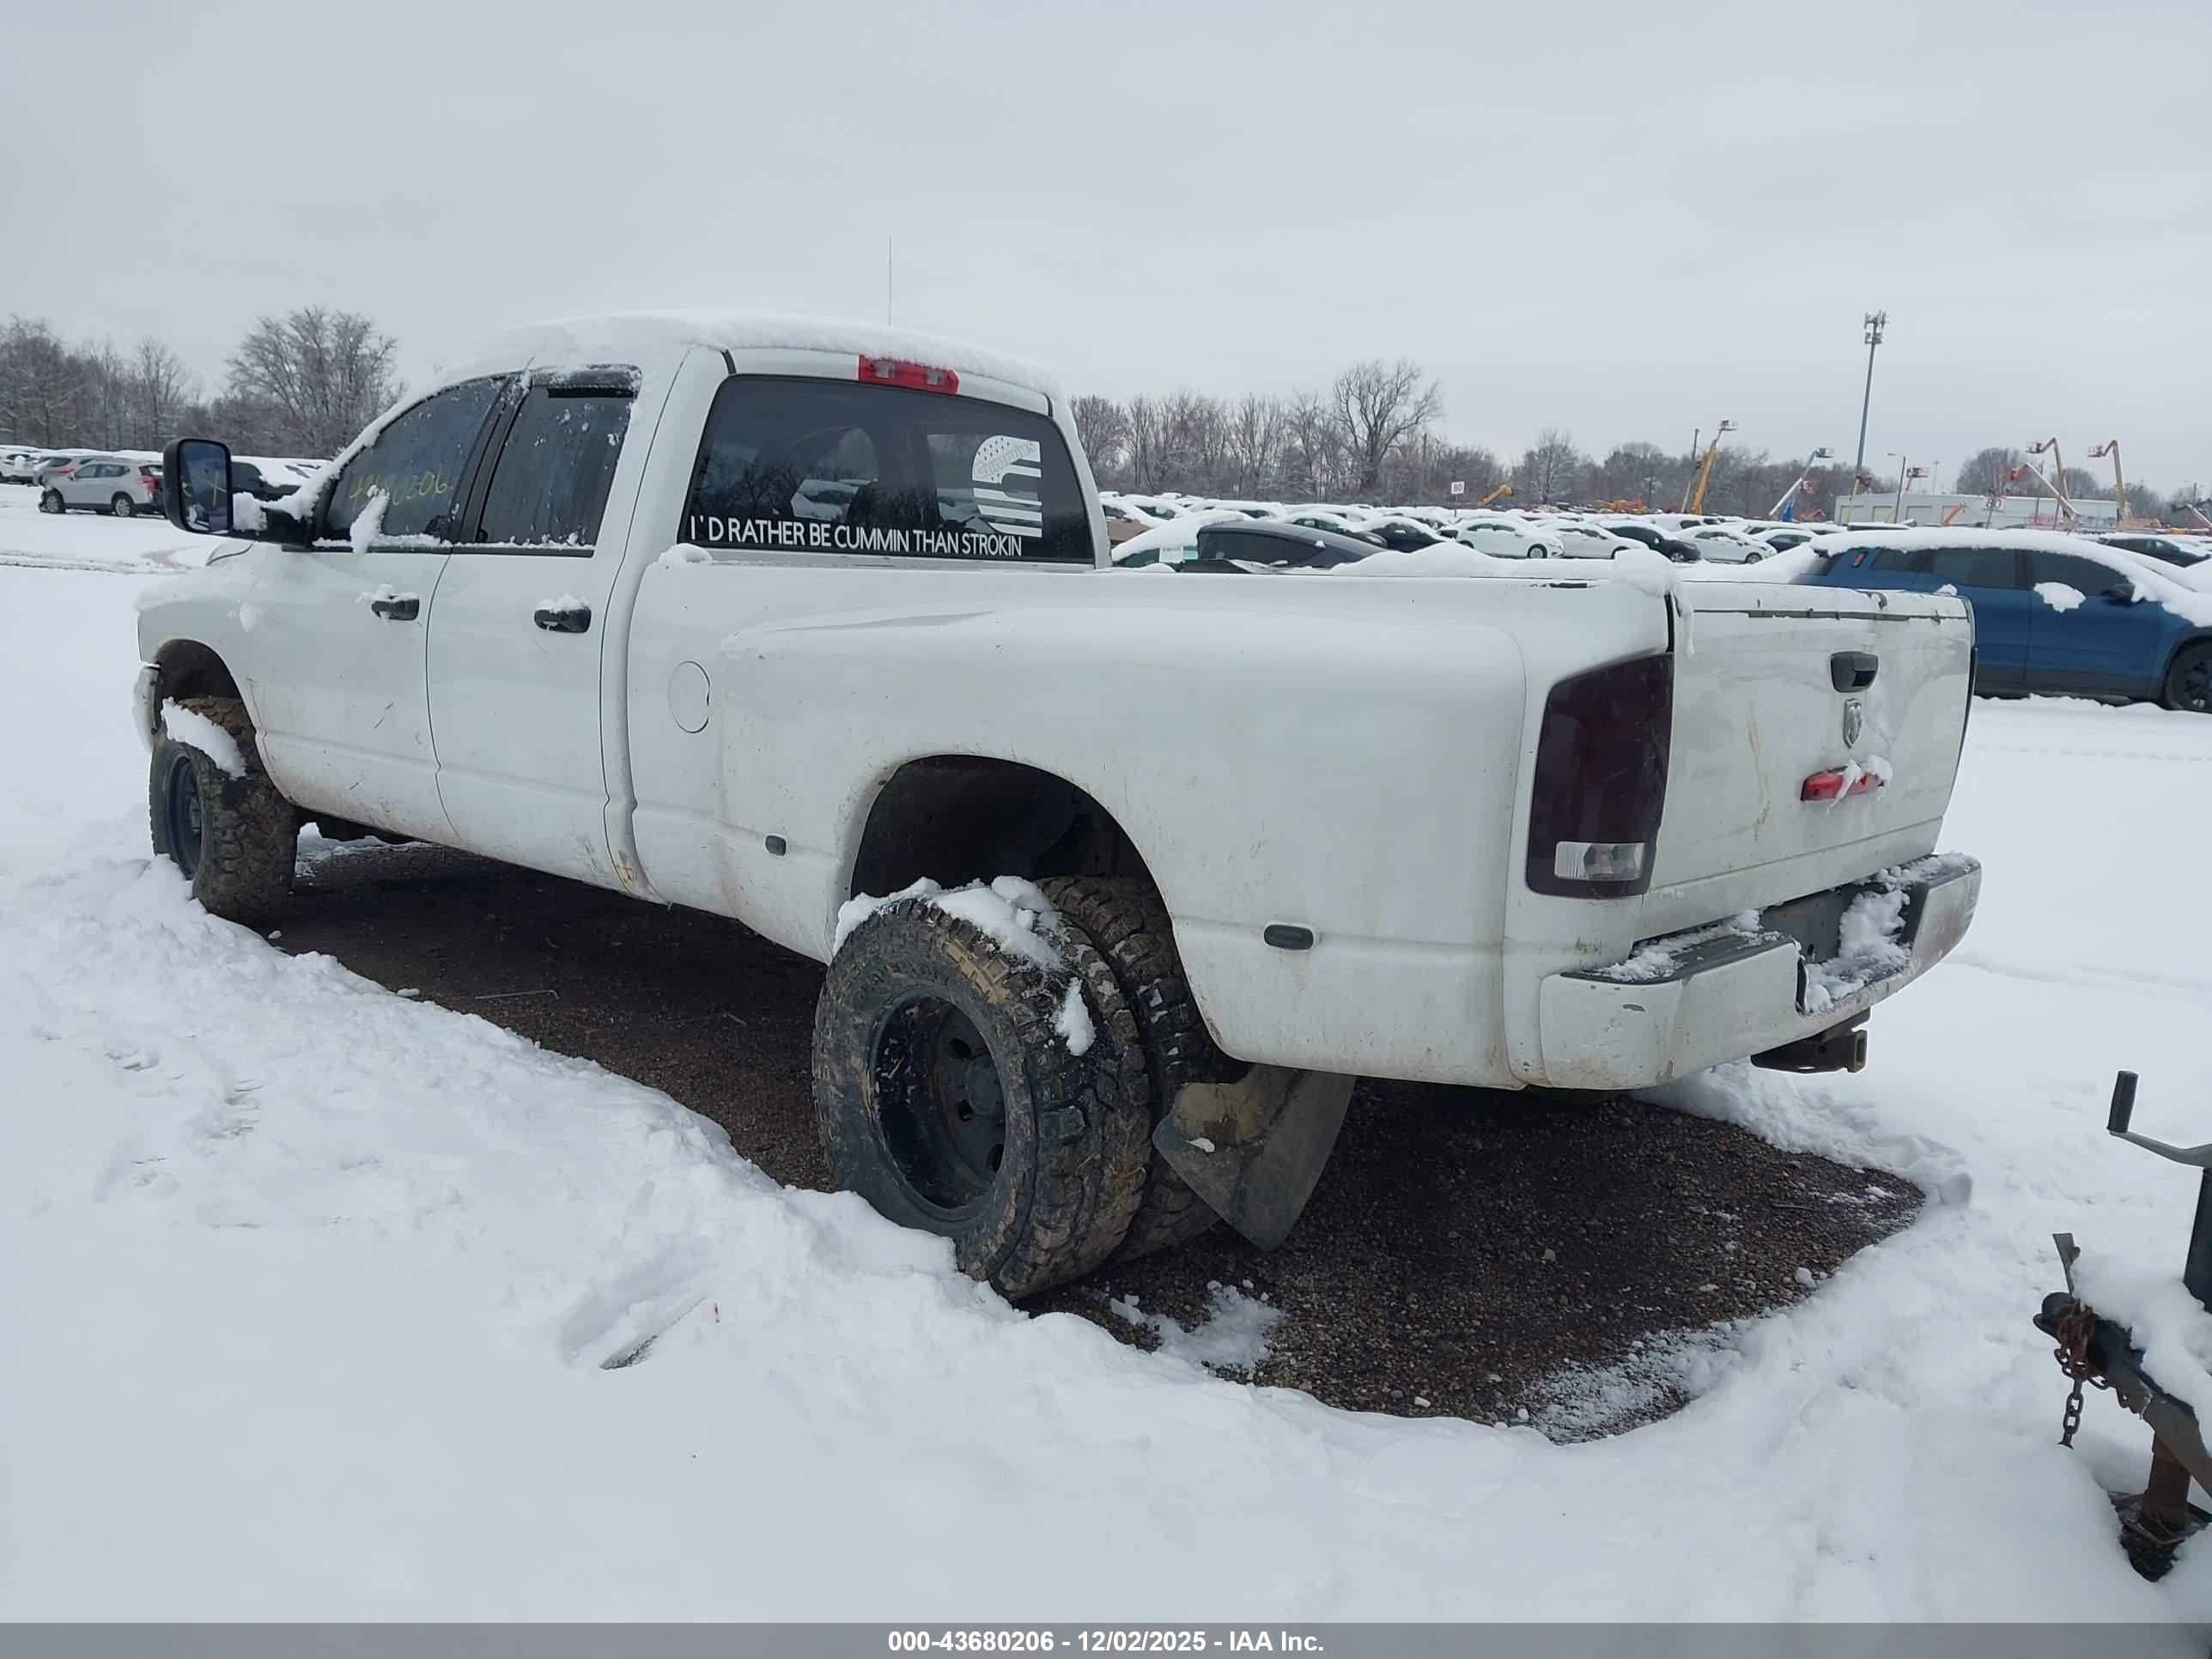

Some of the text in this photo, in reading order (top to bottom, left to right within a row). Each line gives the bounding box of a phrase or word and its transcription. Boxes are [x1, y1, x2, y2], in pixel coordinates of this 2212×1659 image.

[1453, 483, 1463, 493] 80
[1985, 497, 2002, 509] 80
[690, 515, 1023, 556] I'D RATHER BE CUMMIN THAN STROKIN
